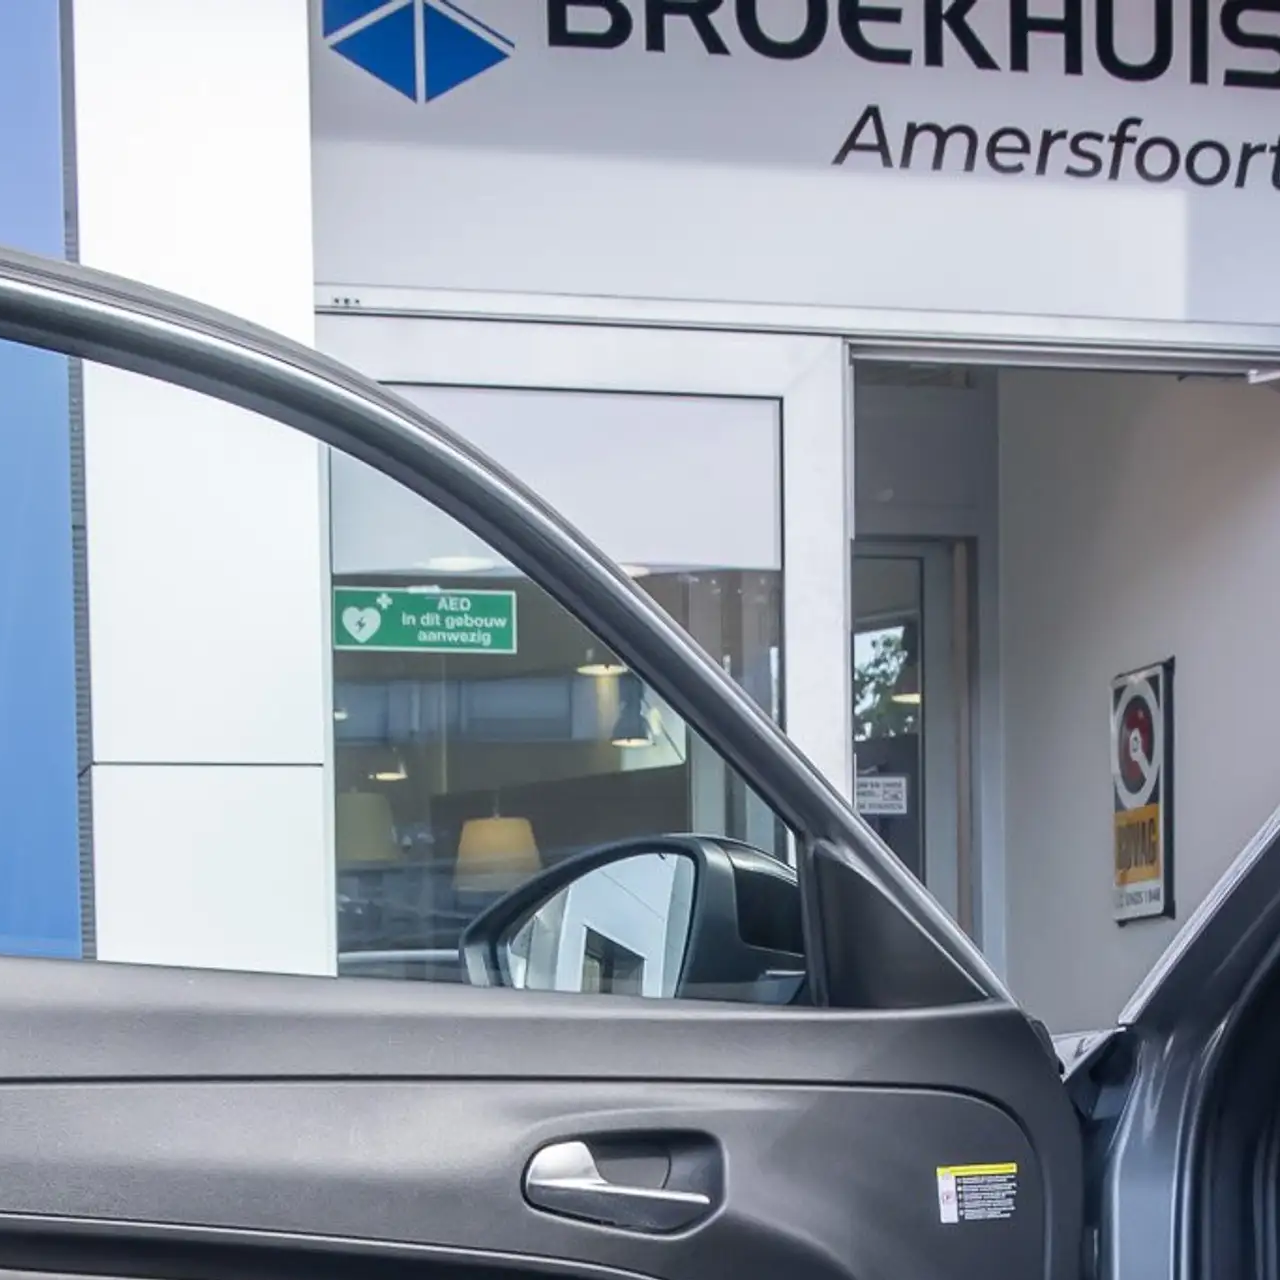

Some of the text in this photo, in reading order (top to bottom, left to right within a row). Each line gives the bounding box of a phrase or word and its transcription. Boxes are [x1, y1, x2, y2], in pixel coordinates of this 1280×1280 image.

[437, 597, 471, 611] AED
[420, 612, 440, 626] dit
[445, 613, 507, 629] gebouw
[417, 630, 491, 646] aanwezig
